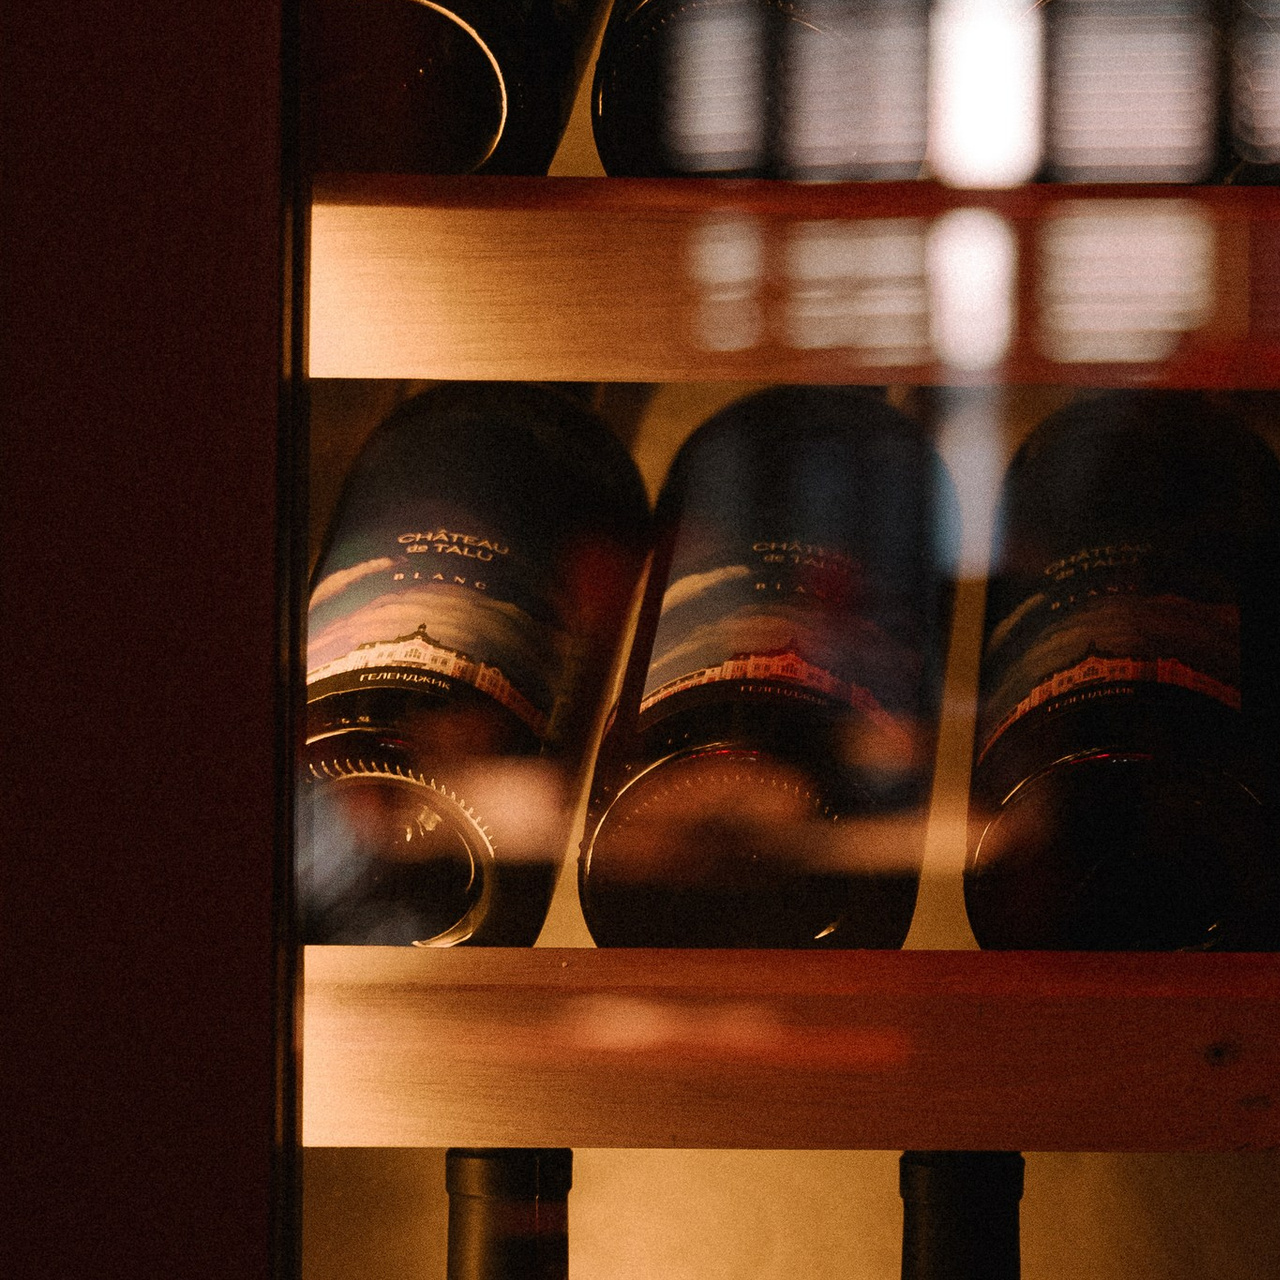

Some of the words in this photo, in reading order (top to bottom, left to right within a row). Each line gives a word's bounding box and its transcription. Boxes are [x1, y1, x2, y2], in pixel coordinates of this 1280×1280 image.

[397, 528, 510, 556] CHÂTEAU
[406, 544, 428, 554] de
[433, 543, 494, 562] TALU
[393, 572, 488, 591] BLANC
[359, 672, 451, 691] ГЕЛЕНДЖИК
